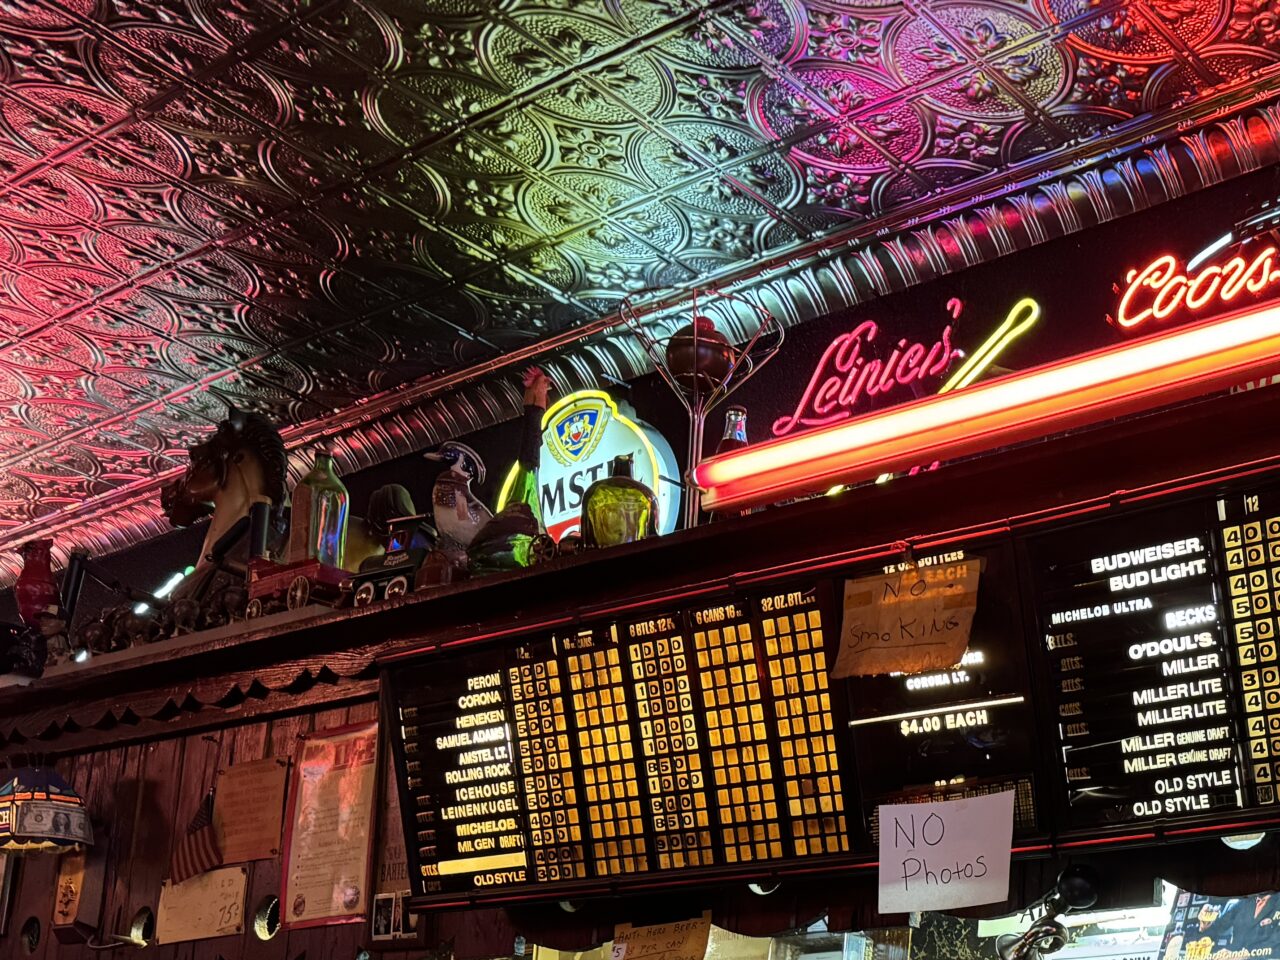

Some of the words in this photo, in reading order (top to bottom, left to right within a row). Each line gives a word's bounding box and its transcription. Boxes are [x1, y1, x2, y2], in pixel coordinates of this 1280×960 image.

[882, 578, 928, 602] NO
[1109, 574, 1149, 591] BUD
[704, 607, 724, 622] CANS
[1052, 604, 1110, 625] MICHELOB
[1113, 598, 1152, 614] ULTRA
[1165, 605, 1216, 629] BECKS
[1162, 654, 1219, 676] MILLER
[468, 674, 501, 690] PERONI
[906, 674, 949, 691] CORONA
[951, 670, 970, 683] LT.
[458, 691, 501, 709] CORONA
[1133, 685, 1188, 706] MILLER
[1190, 678, 1222, 696] LITE
[456, 709, 504, 728] HEINEKEN
[901, 716, 941, 736] $4.00
[946, 709, 988, 730] EACH
[1137, 706, 1193, 727] MILLER
[1193, 700, 1226, 718] LITE
[436, 734, 472, 750] SAMUEL
[472, 727, 505, 743] ADAMS
[1121, 734, 1175, 753] MILLER
[1176, 729, 1208, 745] GENUINE
[1208, 726, 1229, 741] DRAFT
[459, 750, 493, 765] AMSTEL
[1124, 755, 1176, 774] MILLER
[1178, 749, 1208, 765] GENUINE
[1209, 748, 1231, 762] DRAFT
[445, 767, 483, 783] ROLLING
[484, 763, 511, 778] ROCK
[1155, 776, 1183, 794] OLD
[1186, 770, 1231, 790] STYLE
[456, 781, 515, 801] ICEHOUSE
[442, 798, 519, 820] LEINENKUGEL
[1133, 800, 1161, 817] OLD
[1165, 794, 1209, 813] STYLE
[894, 812, 946, 848] NO
[475, 837, 495, 851] GEN
[499, 834, 521, 848] DRAFT
[474, 874, 493, 886] OLD
[493, 870, 526, 885] STYLE
[901, 854, 988, 891] Photos
